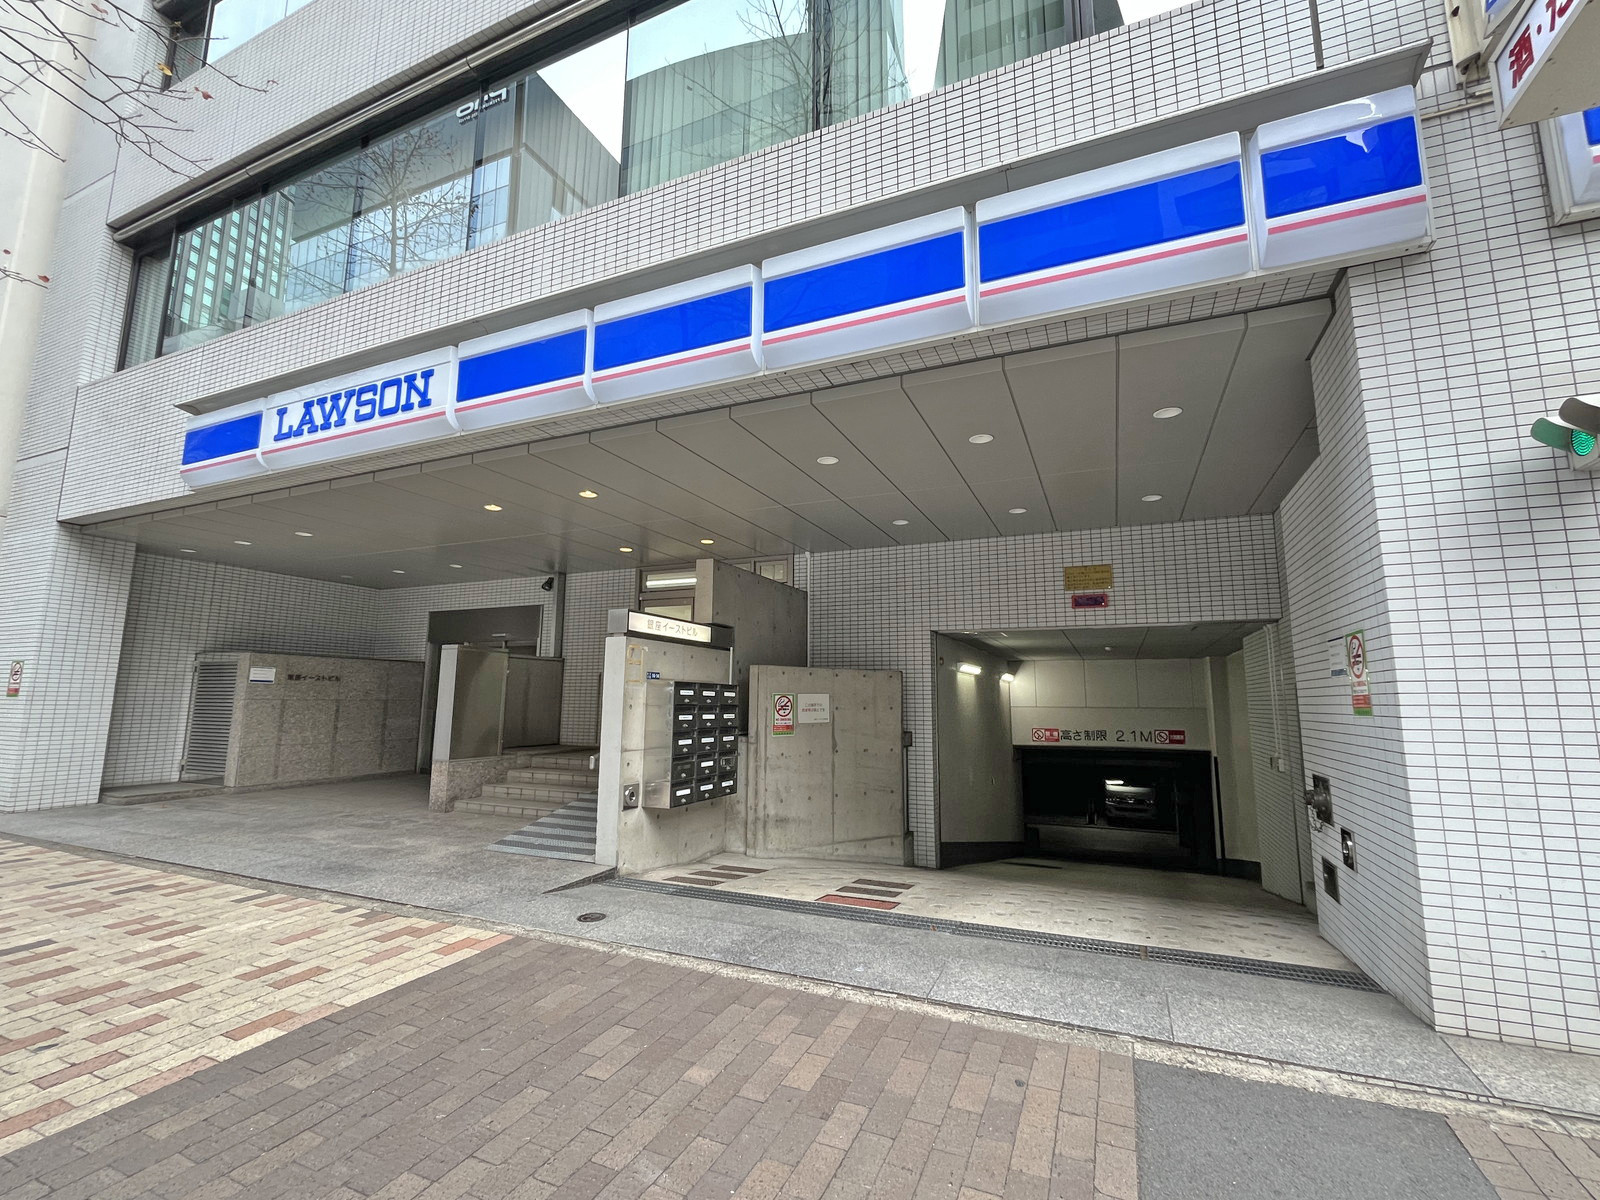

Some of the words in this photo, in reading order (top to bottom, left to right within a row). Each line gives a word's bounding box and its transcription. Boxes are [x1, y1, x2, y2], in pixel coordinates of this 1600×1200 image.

[273, 368, 435, 442] LAWSON
[647, 618, 698, 637] 銀座イーストビル
[1060, 729, 1108, 742] 高さ制限
[1115, 730, 1153, 743] 2.1M
